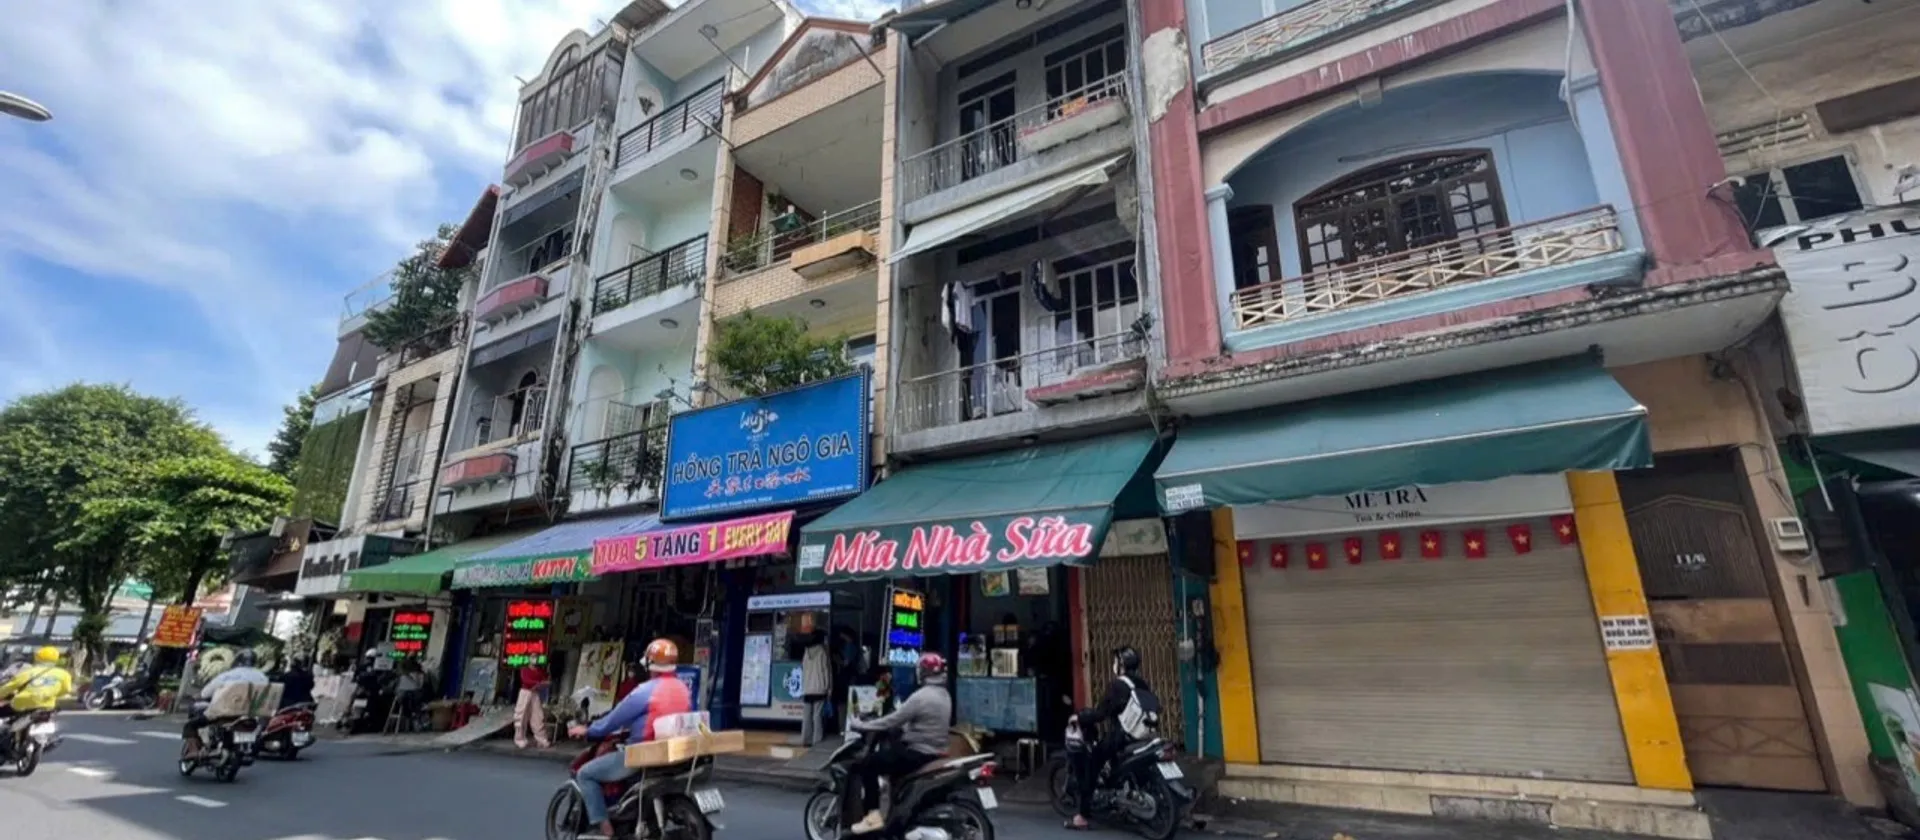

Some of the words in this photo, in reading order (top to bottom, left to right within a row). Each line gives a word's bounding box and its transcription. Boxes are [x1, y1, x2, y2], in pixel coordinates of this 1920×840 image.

[767, 438, 811, 468] NGÔ
[816, 431, 854, 460] GIA
[593, 539, 630, 567] MUA
[634, 535, 648, 561] 5
[708, 526, 719, 552] 1
[724, 523, 763, 550] EVERY
[824, 530, 899, 575] Mía
[902, 521, 992, 570] Nhà
[996, 515, 1093, 562] Sữa
[531, 556, 579, 579] KITTY
